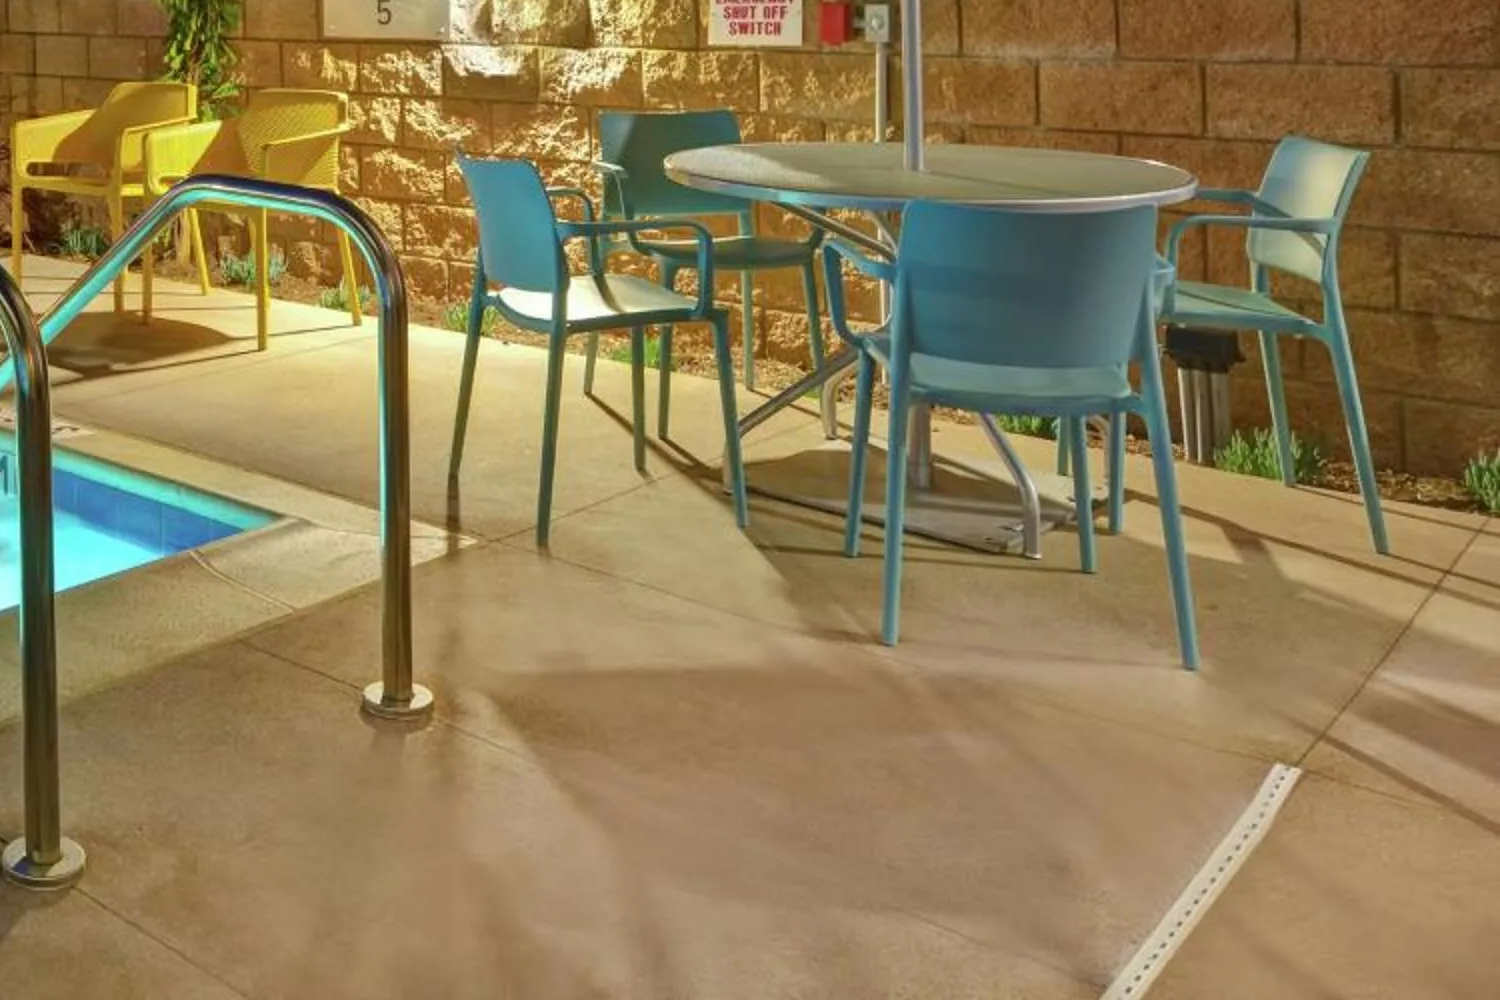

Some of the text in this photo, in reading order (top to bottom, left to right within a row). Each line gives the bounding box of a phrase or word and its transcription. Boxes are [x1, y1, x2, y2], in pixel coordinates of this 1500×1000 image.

[723, 5, 788, 20] SHUT OFF
[728, 21, 782, 37] SWITCH
